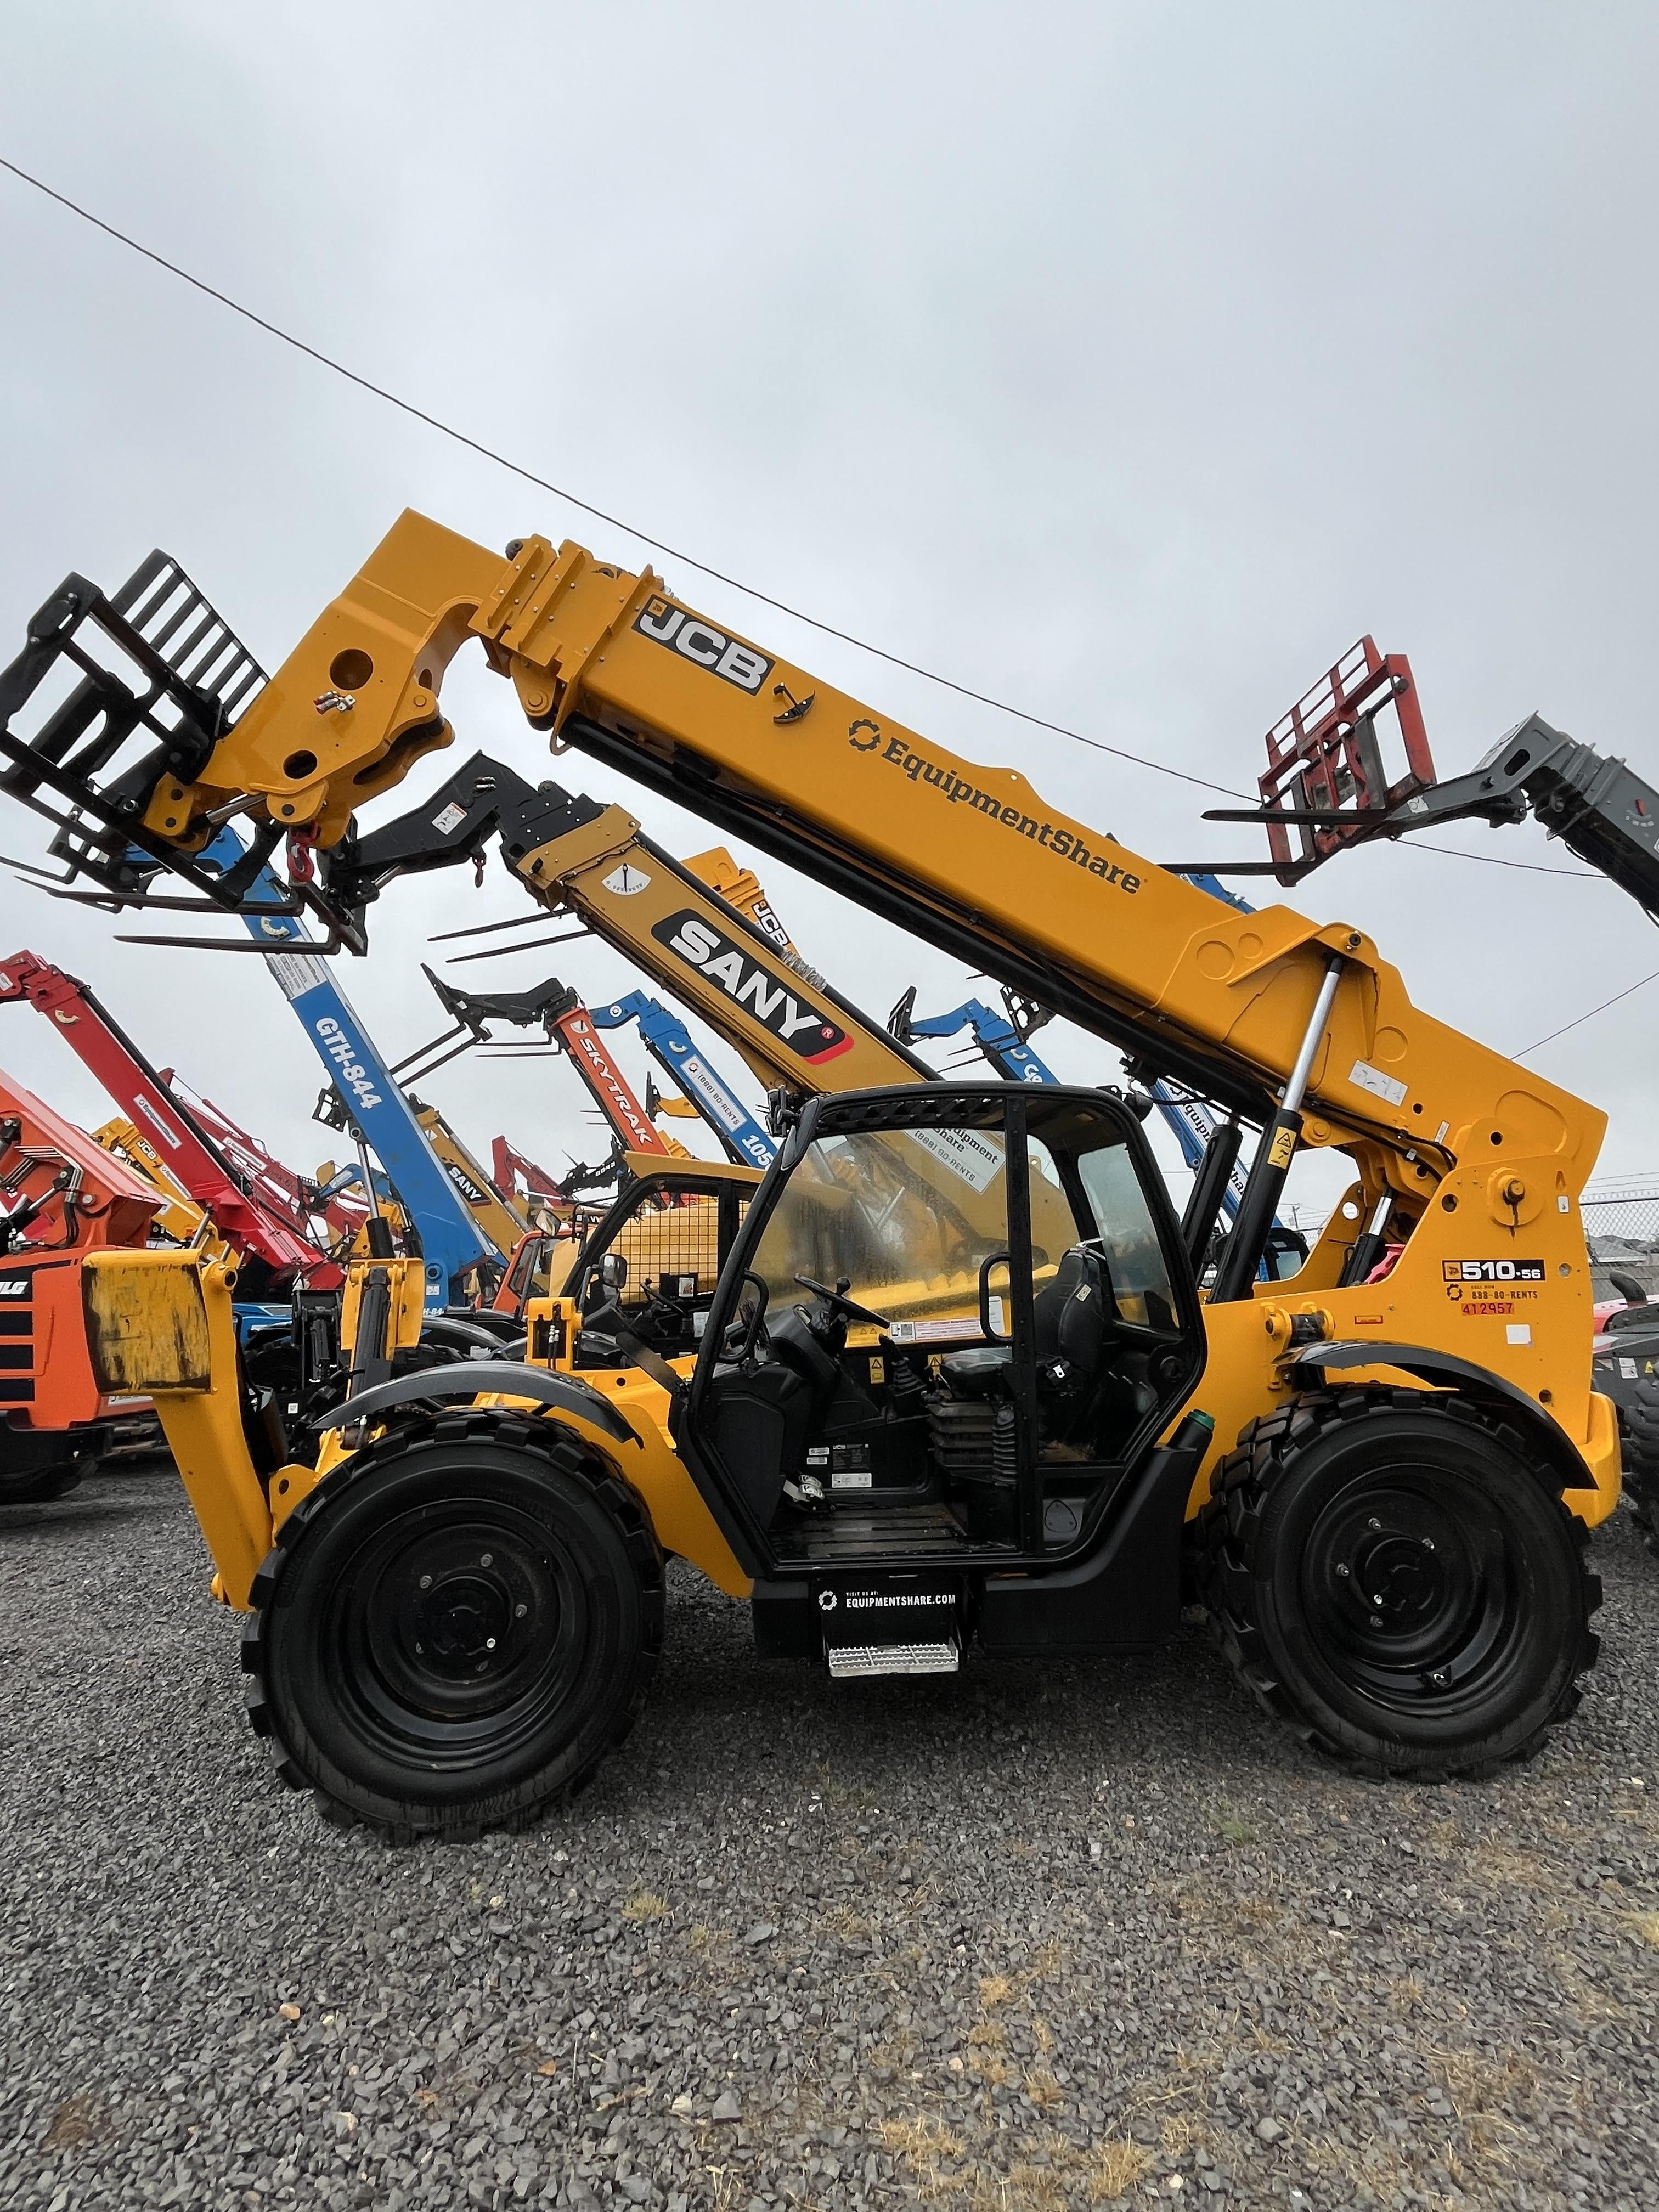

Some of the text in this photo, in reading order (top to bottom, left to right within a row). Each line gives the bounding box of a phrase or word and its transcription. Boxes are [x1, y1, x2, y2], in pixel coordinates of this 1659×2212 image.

[639, 610, 768, 689] JCB
[881, 737, 1141, 895] EquipmentShare
[753, 903, 788, 946] JCB
[669, 920, 823, 1039] SANY
[315, 1017, 383, 1109] GTH-844
[579, 1038, 653, 1144] SKYTRAK
[713, 1093, 740, 1125] 80-RENTS
[137, 1141, 157, 1160] JCB
[742, 1134, 774, 1169] 105
[937, 1148, 976, 1182] 80-RENTS
[448, 1166, 482, 1200] SANY
[1462, 1302, 1513, 1314] 412957
[846, 1594, 956, 1609] EQUIPMENTSHARE.COM
